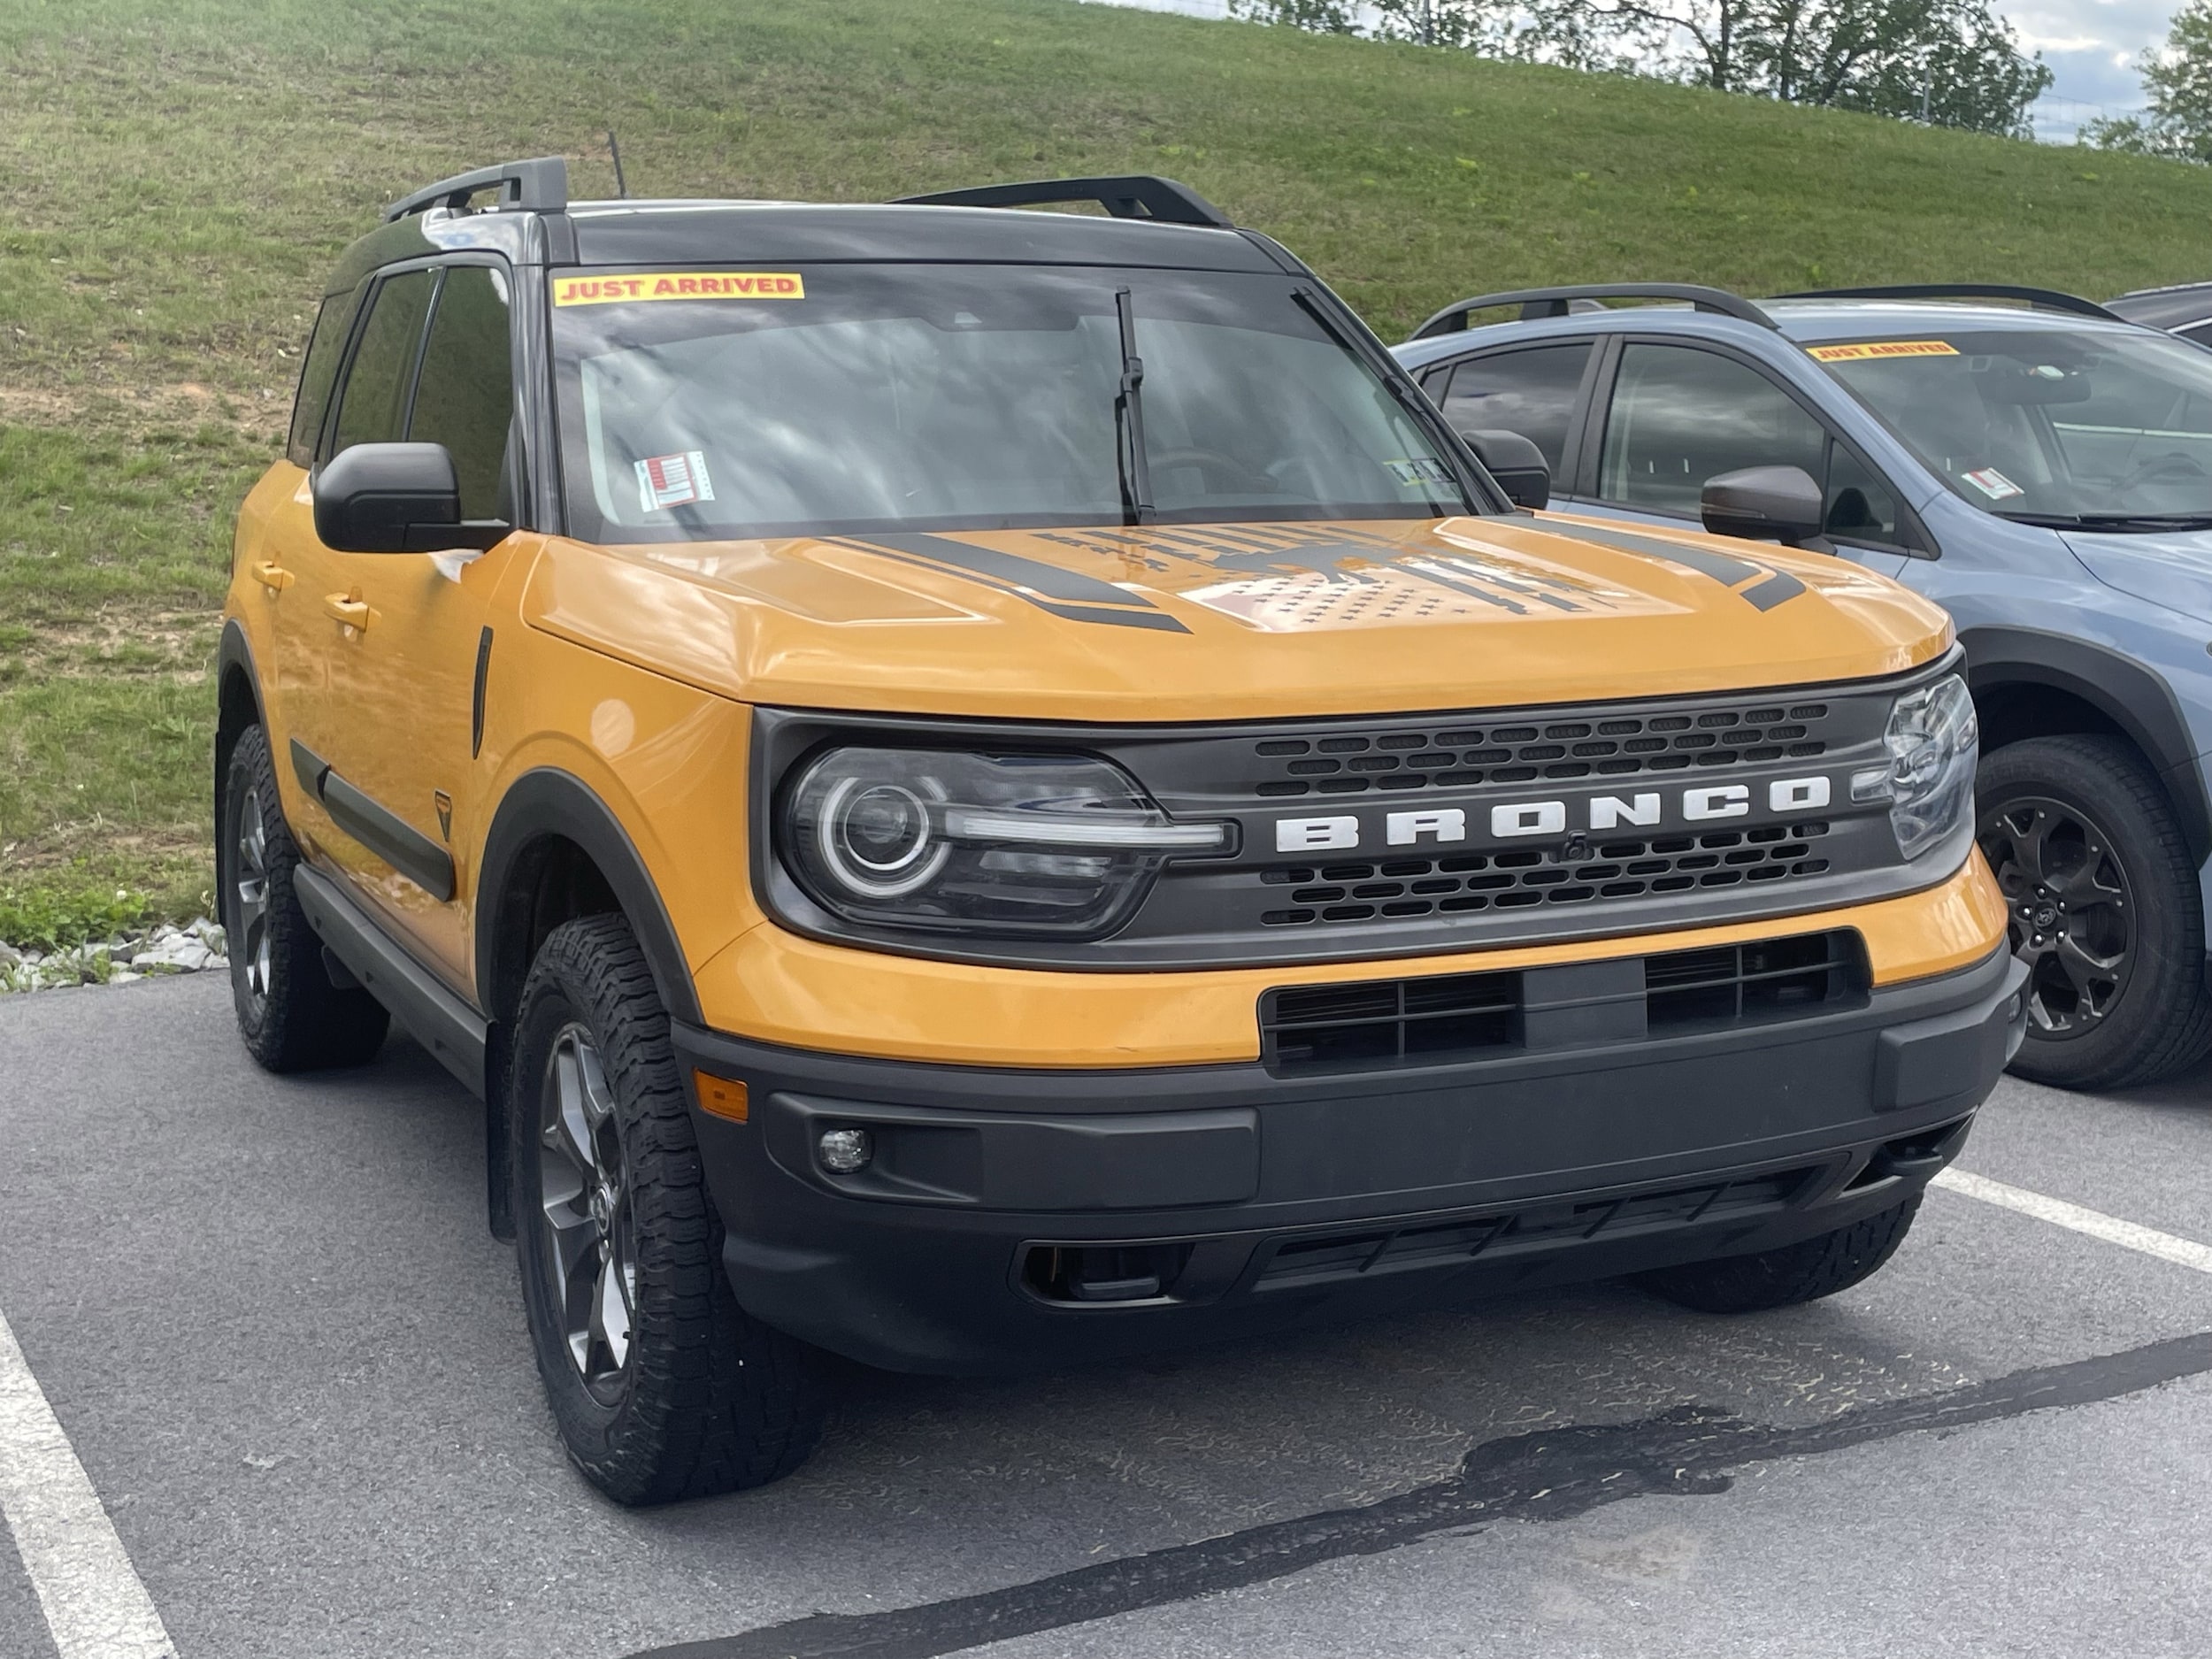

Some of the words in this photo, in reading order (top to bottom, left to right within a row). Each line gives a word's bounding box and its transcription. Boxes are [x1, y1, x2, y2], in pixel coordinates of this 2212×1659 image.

[560, 280, 645, 301] JUST
[653, 277, 797, 296] ARRIVED
[1817, 347, 1865, 358] JUST
[1868, 344, 1952, 355] ARRIVED
[1275, 776, 1831, 853] BRONCO
